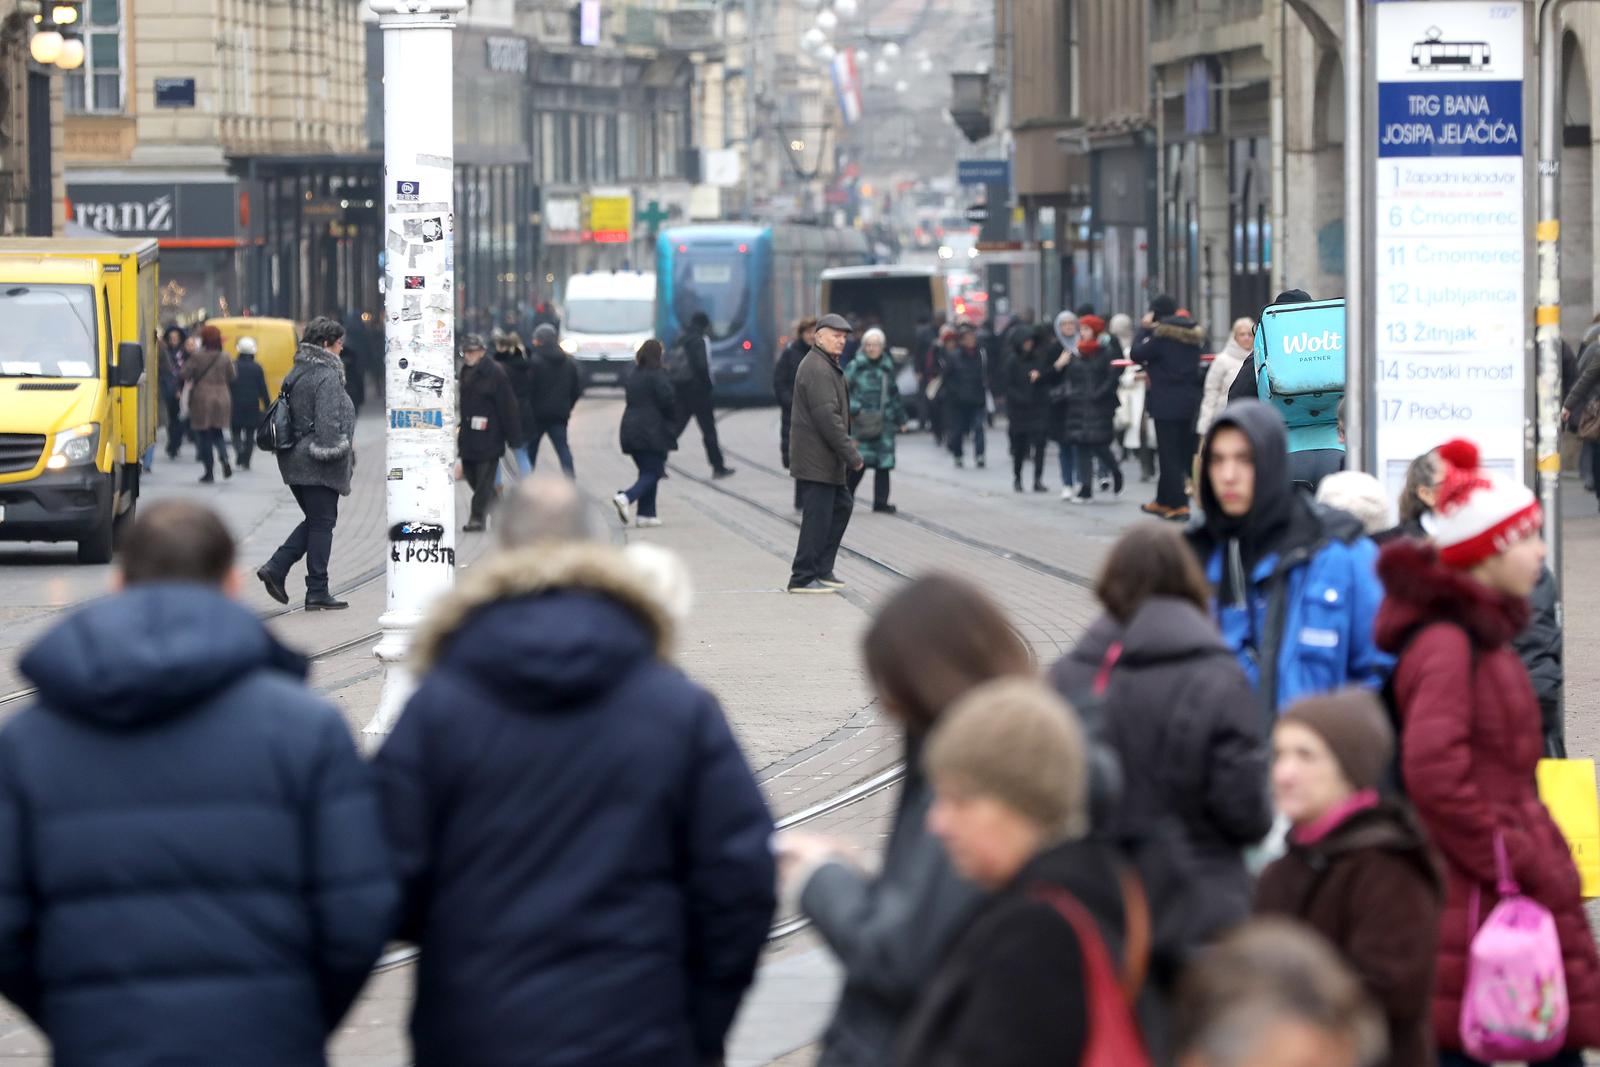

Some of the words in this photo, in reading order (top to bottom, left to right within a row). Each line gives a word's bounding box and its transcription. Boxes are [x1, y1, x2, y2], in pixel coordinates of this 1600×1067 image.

[1408, 95, 1441, 116] TRG
[1444, 95, 1490, 116] BANA
[1382, 123, 1435, 145] JOSIPA
[1438, 118, 1518, 145] JELAČIĆA
[1393, 166, 1399, 187] 1
[1405, 169, 1458, 185] Zapadni
[1462, 170, 1516, 184] kolodvor
[1388, 206, 1402, 227] 6
[1410, 203, 1518, 225] Črnomerec
[1388, 246, 1405, 265] 11
[1415, 242, 1522, 263] Črnomerec
[1388, 284, 1409, 304] 12
[1416, 286, 1517, 307] Ljubljanica
[1283, 329, 1342, 355] Wolt
[1386, 322, 1407, 343] 13
[1414, 320, 1477, 345] Žitnjak
[1378, 359, 1399, 381] 14
[1407, 362, 1460, 380] Savski
[1467, 363, 1513, 380] most
[1382, 399, 1402, 422] 17
[1410, 402, 1472, 421] Prečko
